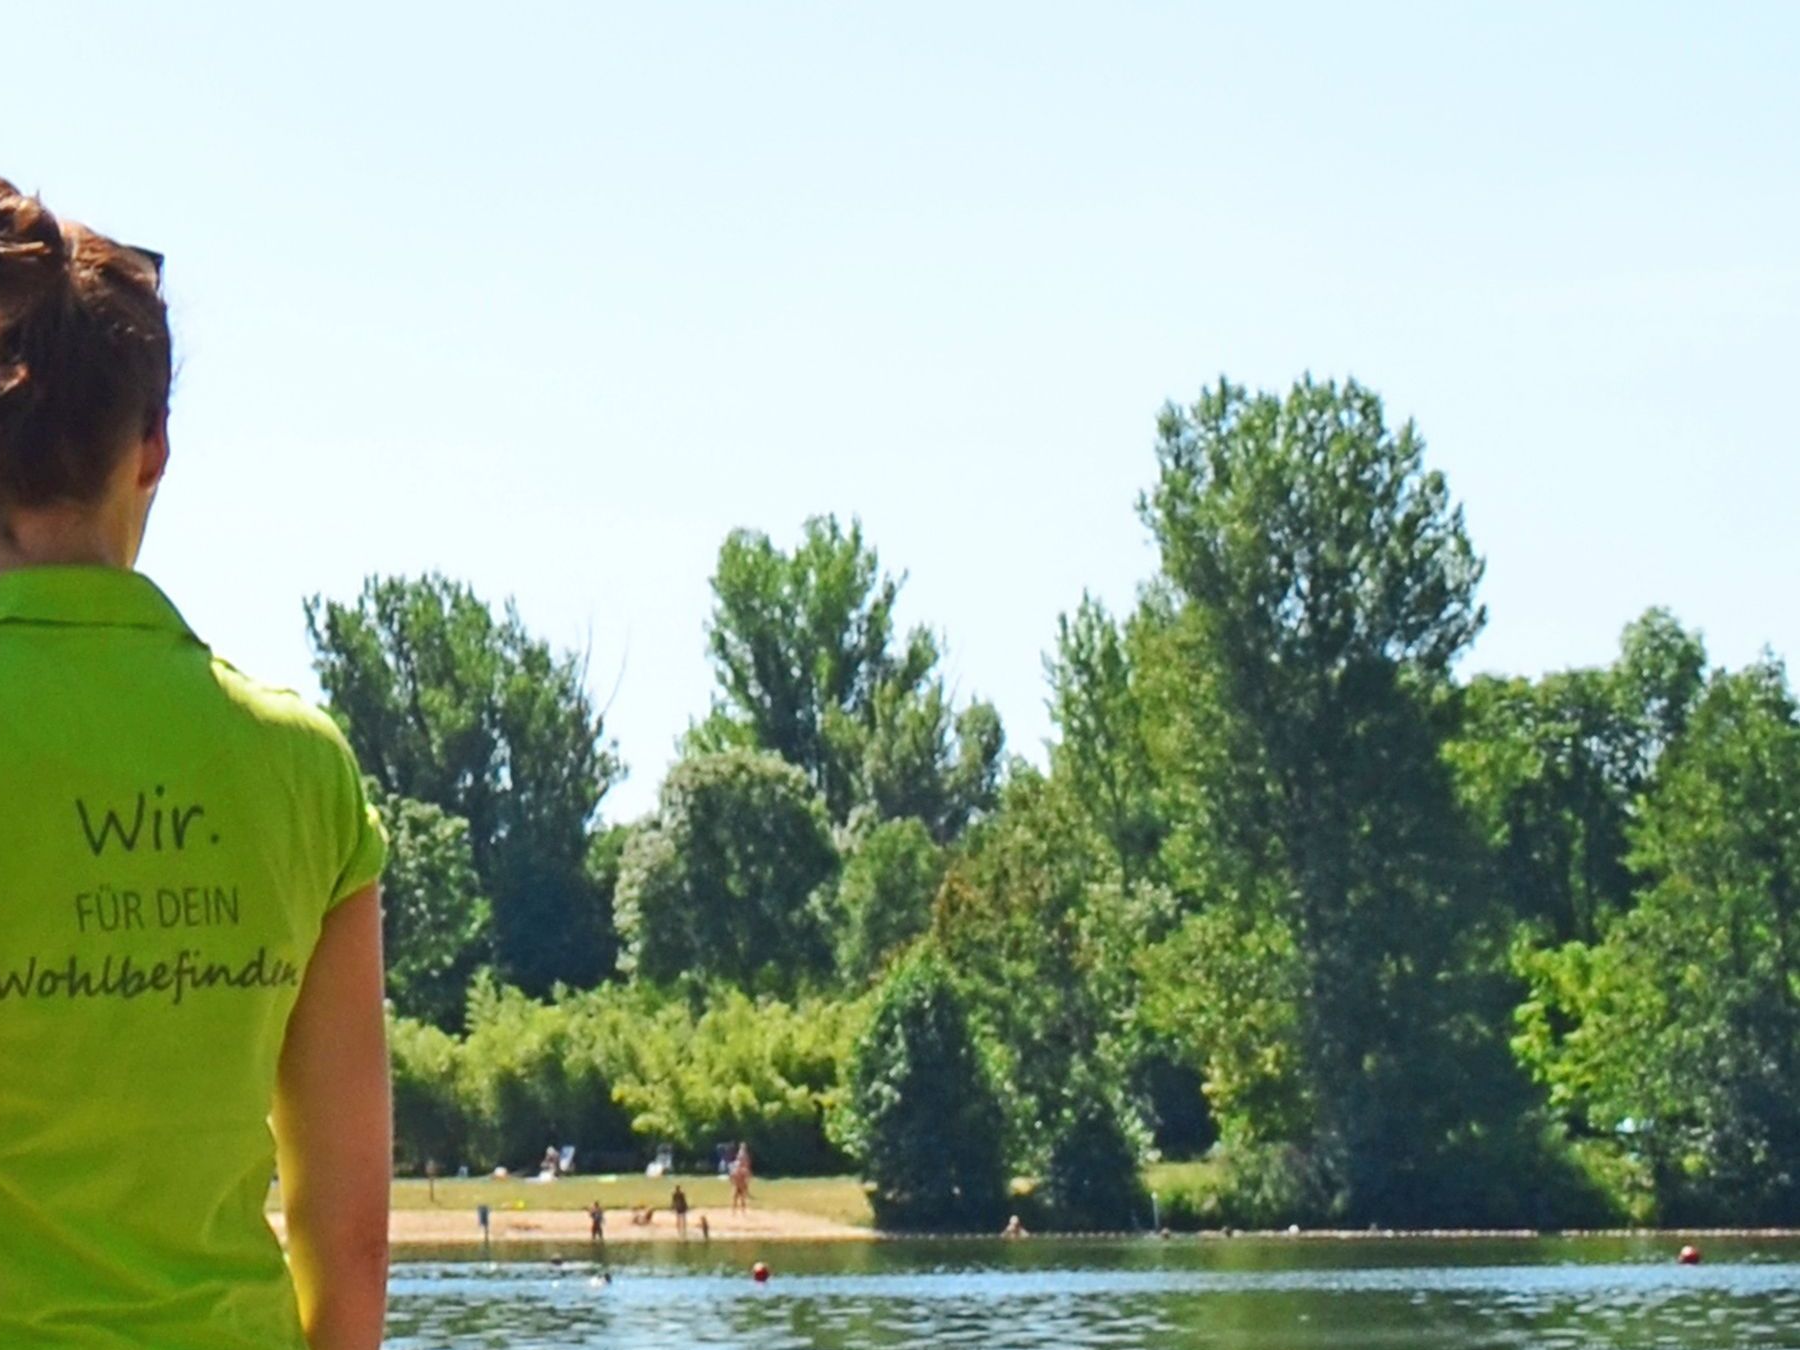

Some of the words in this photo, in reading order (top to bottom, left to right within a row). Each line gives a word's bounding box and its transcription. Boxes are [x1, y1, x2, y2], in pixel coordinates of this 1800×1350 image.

[75, 785, 220, 856] Wir.
[76, 885, 145, 932] FÜR
[157, 886, 239, 928] DEIN
